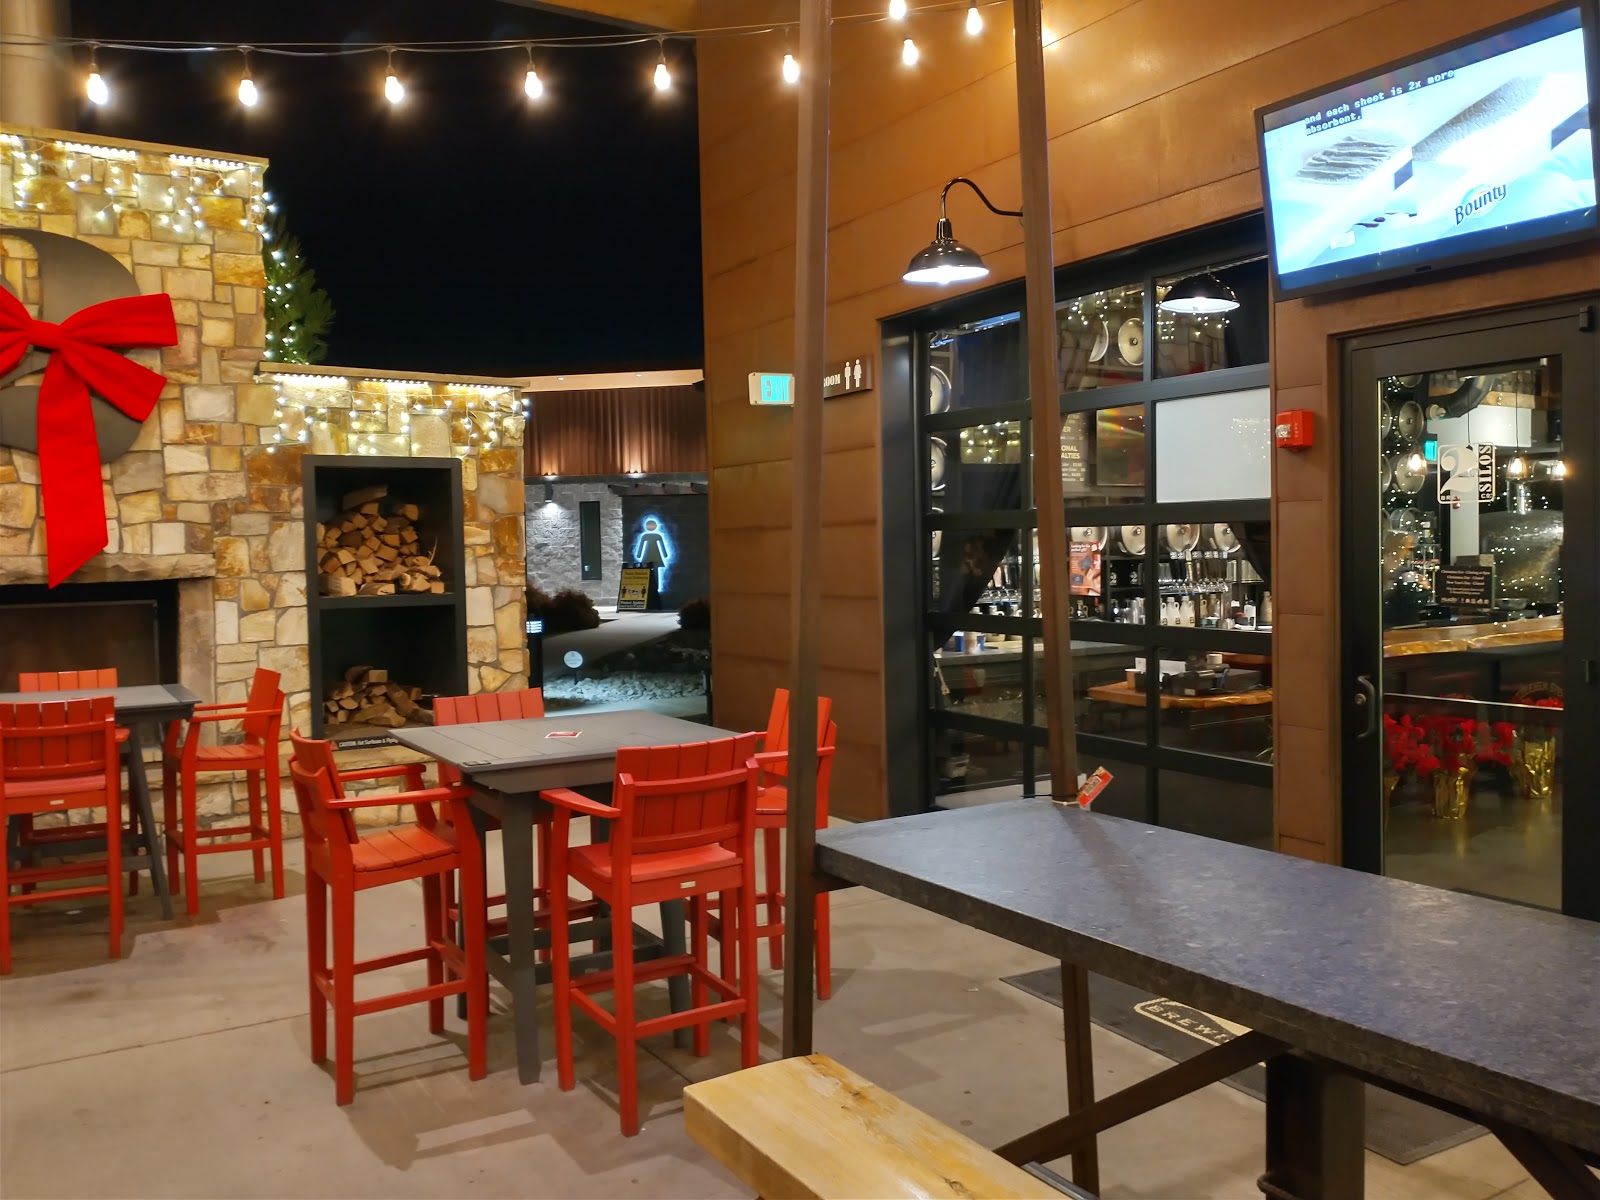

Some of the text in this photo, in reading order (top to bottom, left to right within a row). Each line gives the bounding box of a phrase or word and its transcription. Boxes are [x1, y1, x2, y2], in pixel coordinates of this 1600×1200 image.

[1304, 70, 1455, 124] and each sheet is 2x more
[1454, 184, 1507, 225] Bounty
[761, 375, 790, 402] EXIT
[1440, 446, 1478, 494] 2
[1478, 445, 1492, 492] SILOS
